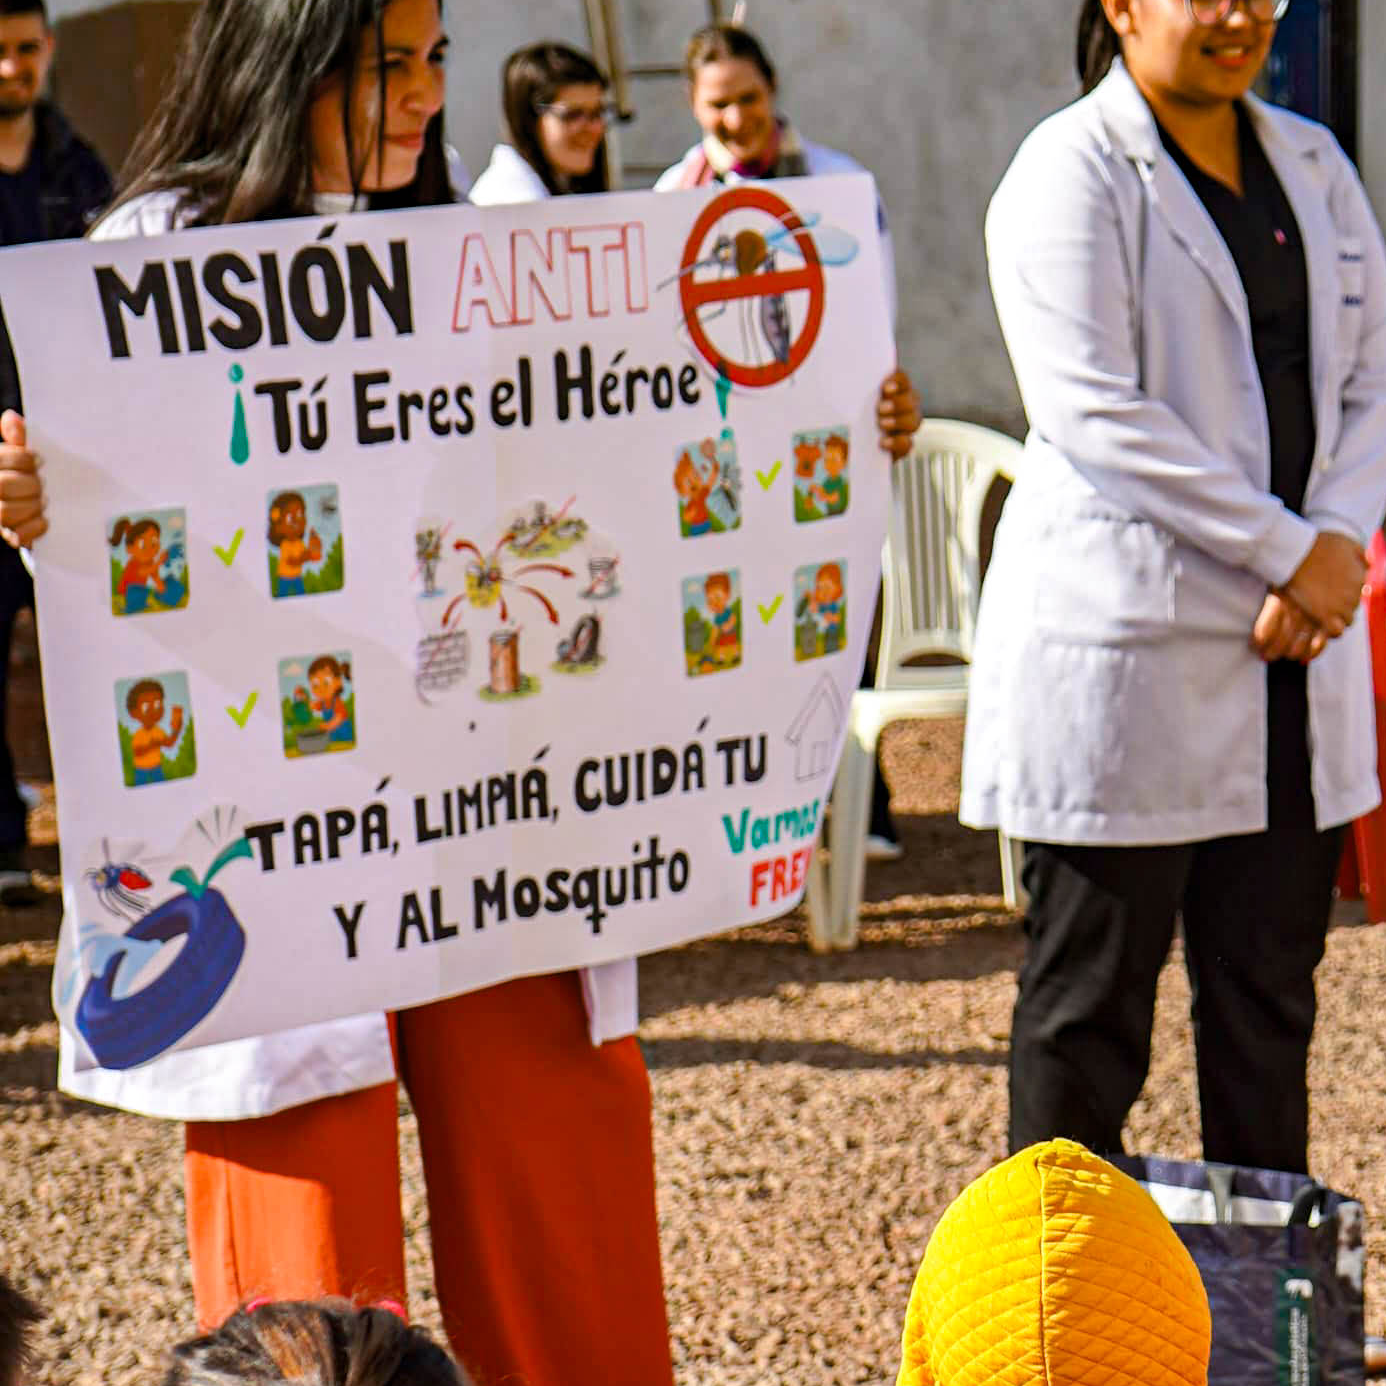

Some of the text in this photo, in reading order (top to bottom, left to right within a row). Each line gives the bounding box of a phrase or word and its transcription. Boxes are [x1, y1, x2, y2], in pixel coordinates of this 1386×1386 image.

[93, 221, 651, 360] MISIÓN ANTI
[228, 363, 328, 465] ¡Tú
[353, 370, 475, 446] Eres
[490, 357, 532, 428] el
[244, 775, 399, 872] TAPÁ,
[575, 715, 710, 813] CUIDÁ
[716, 733, 768, 786] TU
[332, 836, 690, 959] Y AL Mosquito
